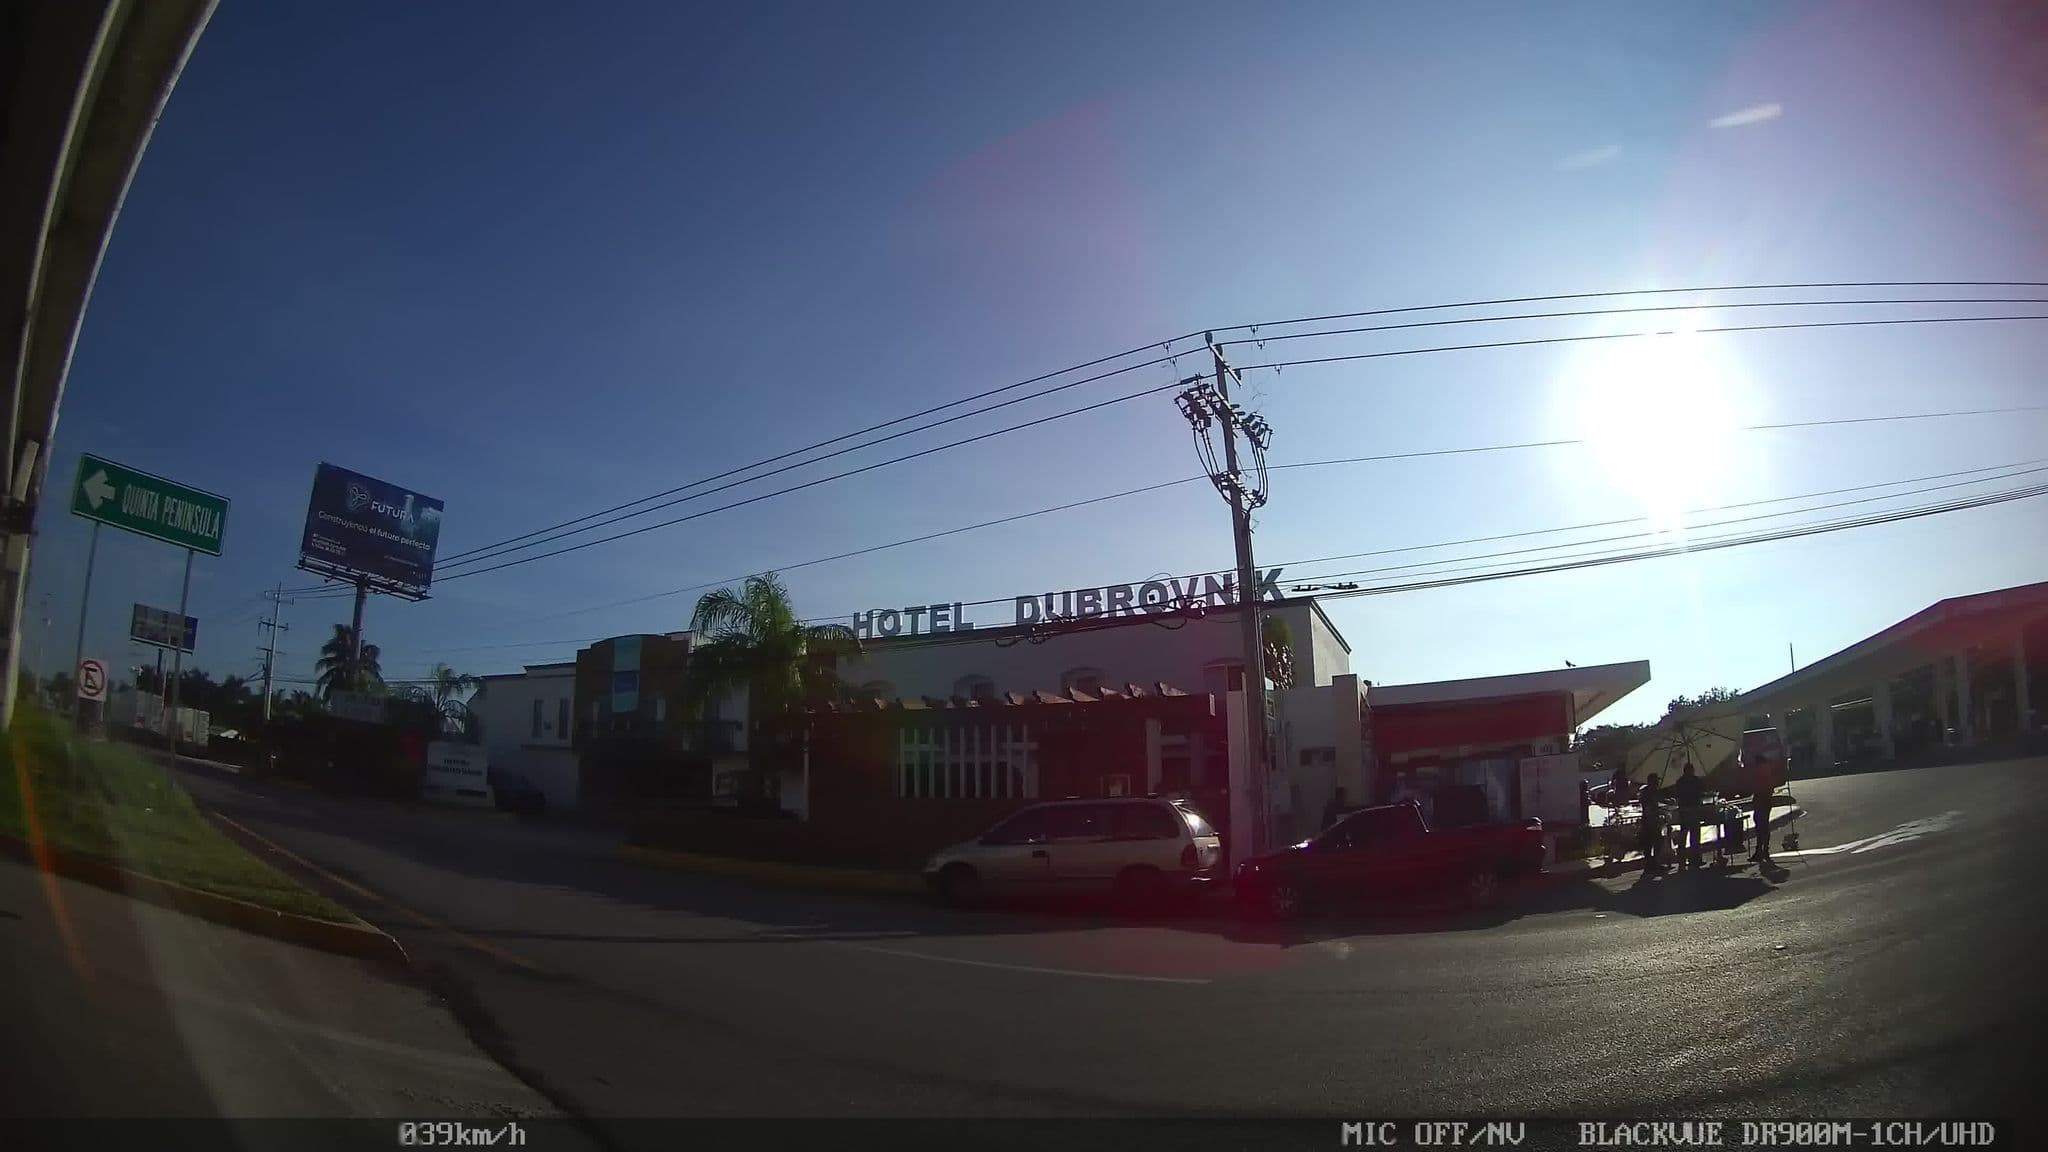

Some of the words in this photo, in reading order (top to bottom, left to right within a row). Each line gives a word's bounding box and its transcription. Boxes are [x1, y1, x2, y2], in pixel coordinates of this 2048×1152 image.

[122, 484, 160, 520] QUINTA
[161, 496, 220, 538] PENINSULA
[371, 501, 414, 523] FUTURA
[400, 537, 431, 550] perfecto
[853, 602, 975, 639] HOTEL
[1016, 568, 1286, 625] DUBROVNK
